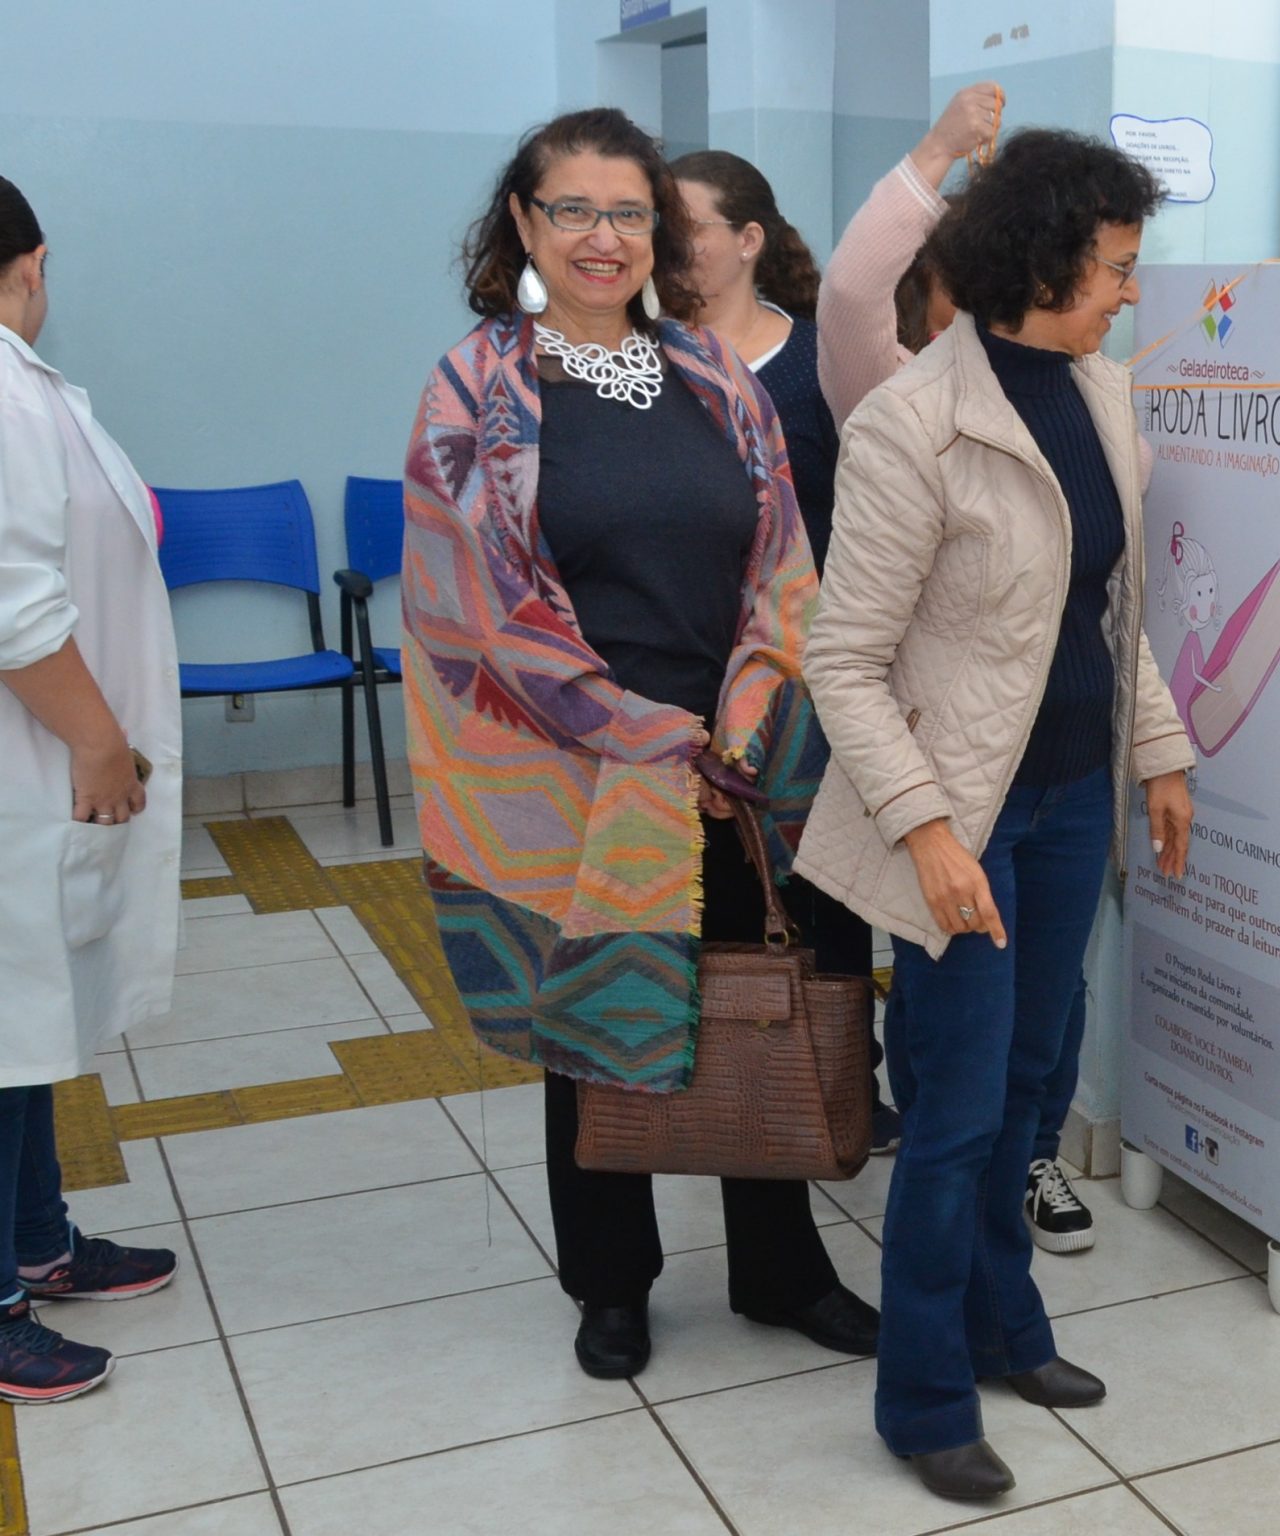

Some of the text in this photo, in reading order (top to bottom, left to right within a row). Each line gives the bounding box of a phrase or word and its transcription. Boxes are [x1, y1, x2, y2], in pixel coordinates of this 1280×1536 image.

[1179, 358, 1249, 381] Geladeiroteca
[1150, 388, 1207, 437] RODA
[1157, 444, 1280, 477] ALIMENTANDO A IMAGINAÇÃO
[1189, 823, 1208, 841] VRO
[1210, 830, 1233, 851] COM
[1137, 865, 1150, 880] por
[1167, 875, 1186, 897] livro
[1188, 888, 1203, 904] seu
[1205, 895, 1226, 914] para
[1228, 905, 1247, 923] que
[1199, 873, 1211, 886] ou
[1213, 873, 1259, 906] TROQUE
[1135, 884, 1190, 919] compartilhem
[1192, 907, 1203, 925] do
[1205, 918, 1235, 939] prazer
[1237, 926, 1250, 945] da
[1165, 952, 1172, 965] O
[1173, 955, 1197, 977] Projeto
[1197, 966, 1215, 986] Roda
[1216, 975, 1236, 996] Livro
[1154, 966, 1168, 980] uma
[1199, 985, 1208, 1000] da
[1208, 994, 1255, 1024] comunidade.
[1186, 1001, 1215, 1021] mantido
[1216, 1015, 1229, 1028] por
[1230, 1020, 1274, 1051] voluntários.
[1194, 1035, 1216, 1054] VOCÊ
[1170, 1039, 1204, 1067] DOANDO
